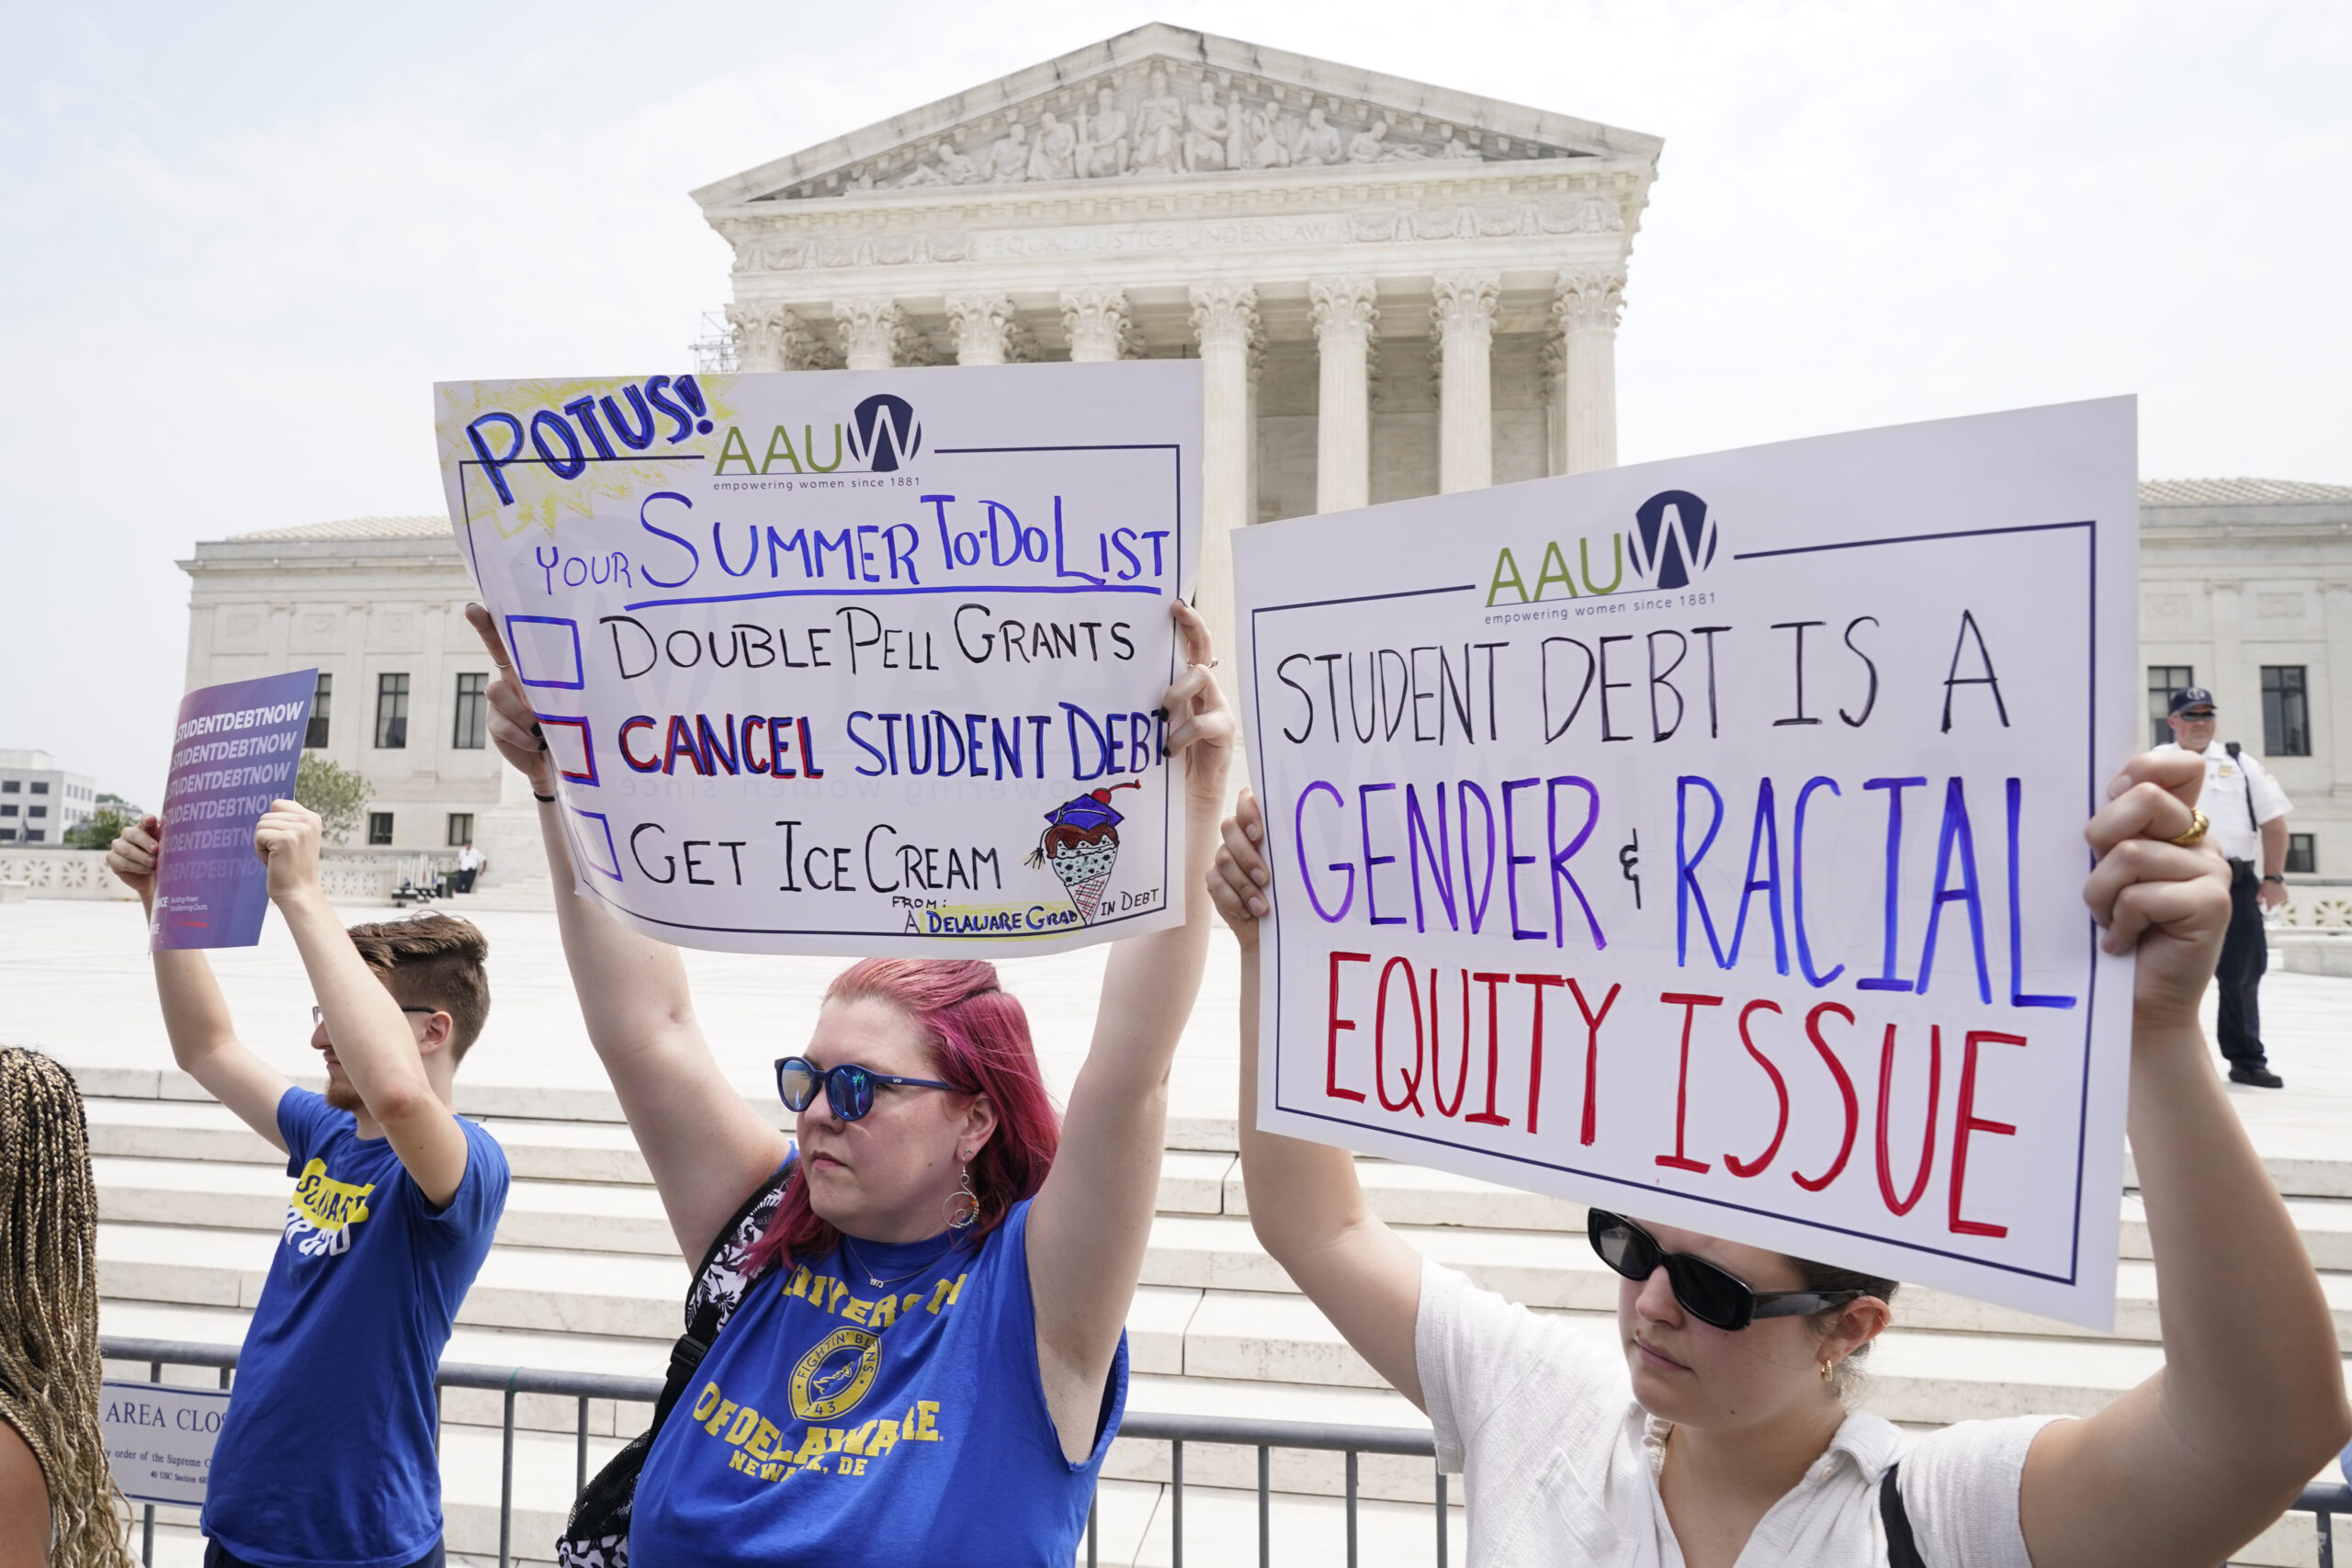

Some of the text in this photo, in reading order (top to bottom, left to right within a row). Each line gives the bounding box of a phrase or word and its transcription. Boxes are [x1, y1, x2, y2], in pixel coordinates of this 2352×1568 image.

[993, 221, 1326, 255] EQUAL JUSTICE UNDER LAW
[466, 374, 714, 507] POTUS!
[715, 393, 922, 476] AAUW
[713, 477, 920, 492] empowering women since 1881
[640, 491, 920, 588] SUMMER
[1054, 495, 1170, 585] LIST
[1487, 490, 1717, 606] AAUW
[1485, 592, 1715, 625] empowering women since 1881
[599, 604, 1135, 679] DOUBLE PELL GRANTS
[1276, 609, 2011, 746] STUDENT DEBT IS A
[174, 701, 304, 745] STUDENTDEBTNOW
[618, 702, 1166, 781] CANCEL STUDENT DEBT
[169, 731, 298, 773] STUDENTDEBTNOW
[630, 820, 1001, 893] GET ICE CREAM
[892, 896, 947, 909] FROM:
[1101, 888, 1159, 917] IN DEBT
[1295, 775, 2076, 1009] GENDER & RACIAL
[904, 906, 1079, 933] A DELAWARE GRAD
[1326, 951, 2027, 1238] EQUITY ISSUE
[797, 1331, 850, 1379] FIGHTIN'
[106, 1402, 166, 1427] AREA
[693, 1381, 739, 1437] OF
[115, 1450, 137, 1460] order
[140, 1451, 150, 1461] of
[152, 1452, 164, 1463] the
[167, 1454, 201, 1468] Supreme
[160, 1472, 172, 1481] USC
[175, 1472, 197, 1483] Section
[838, 1456, 868, 1476] DE
